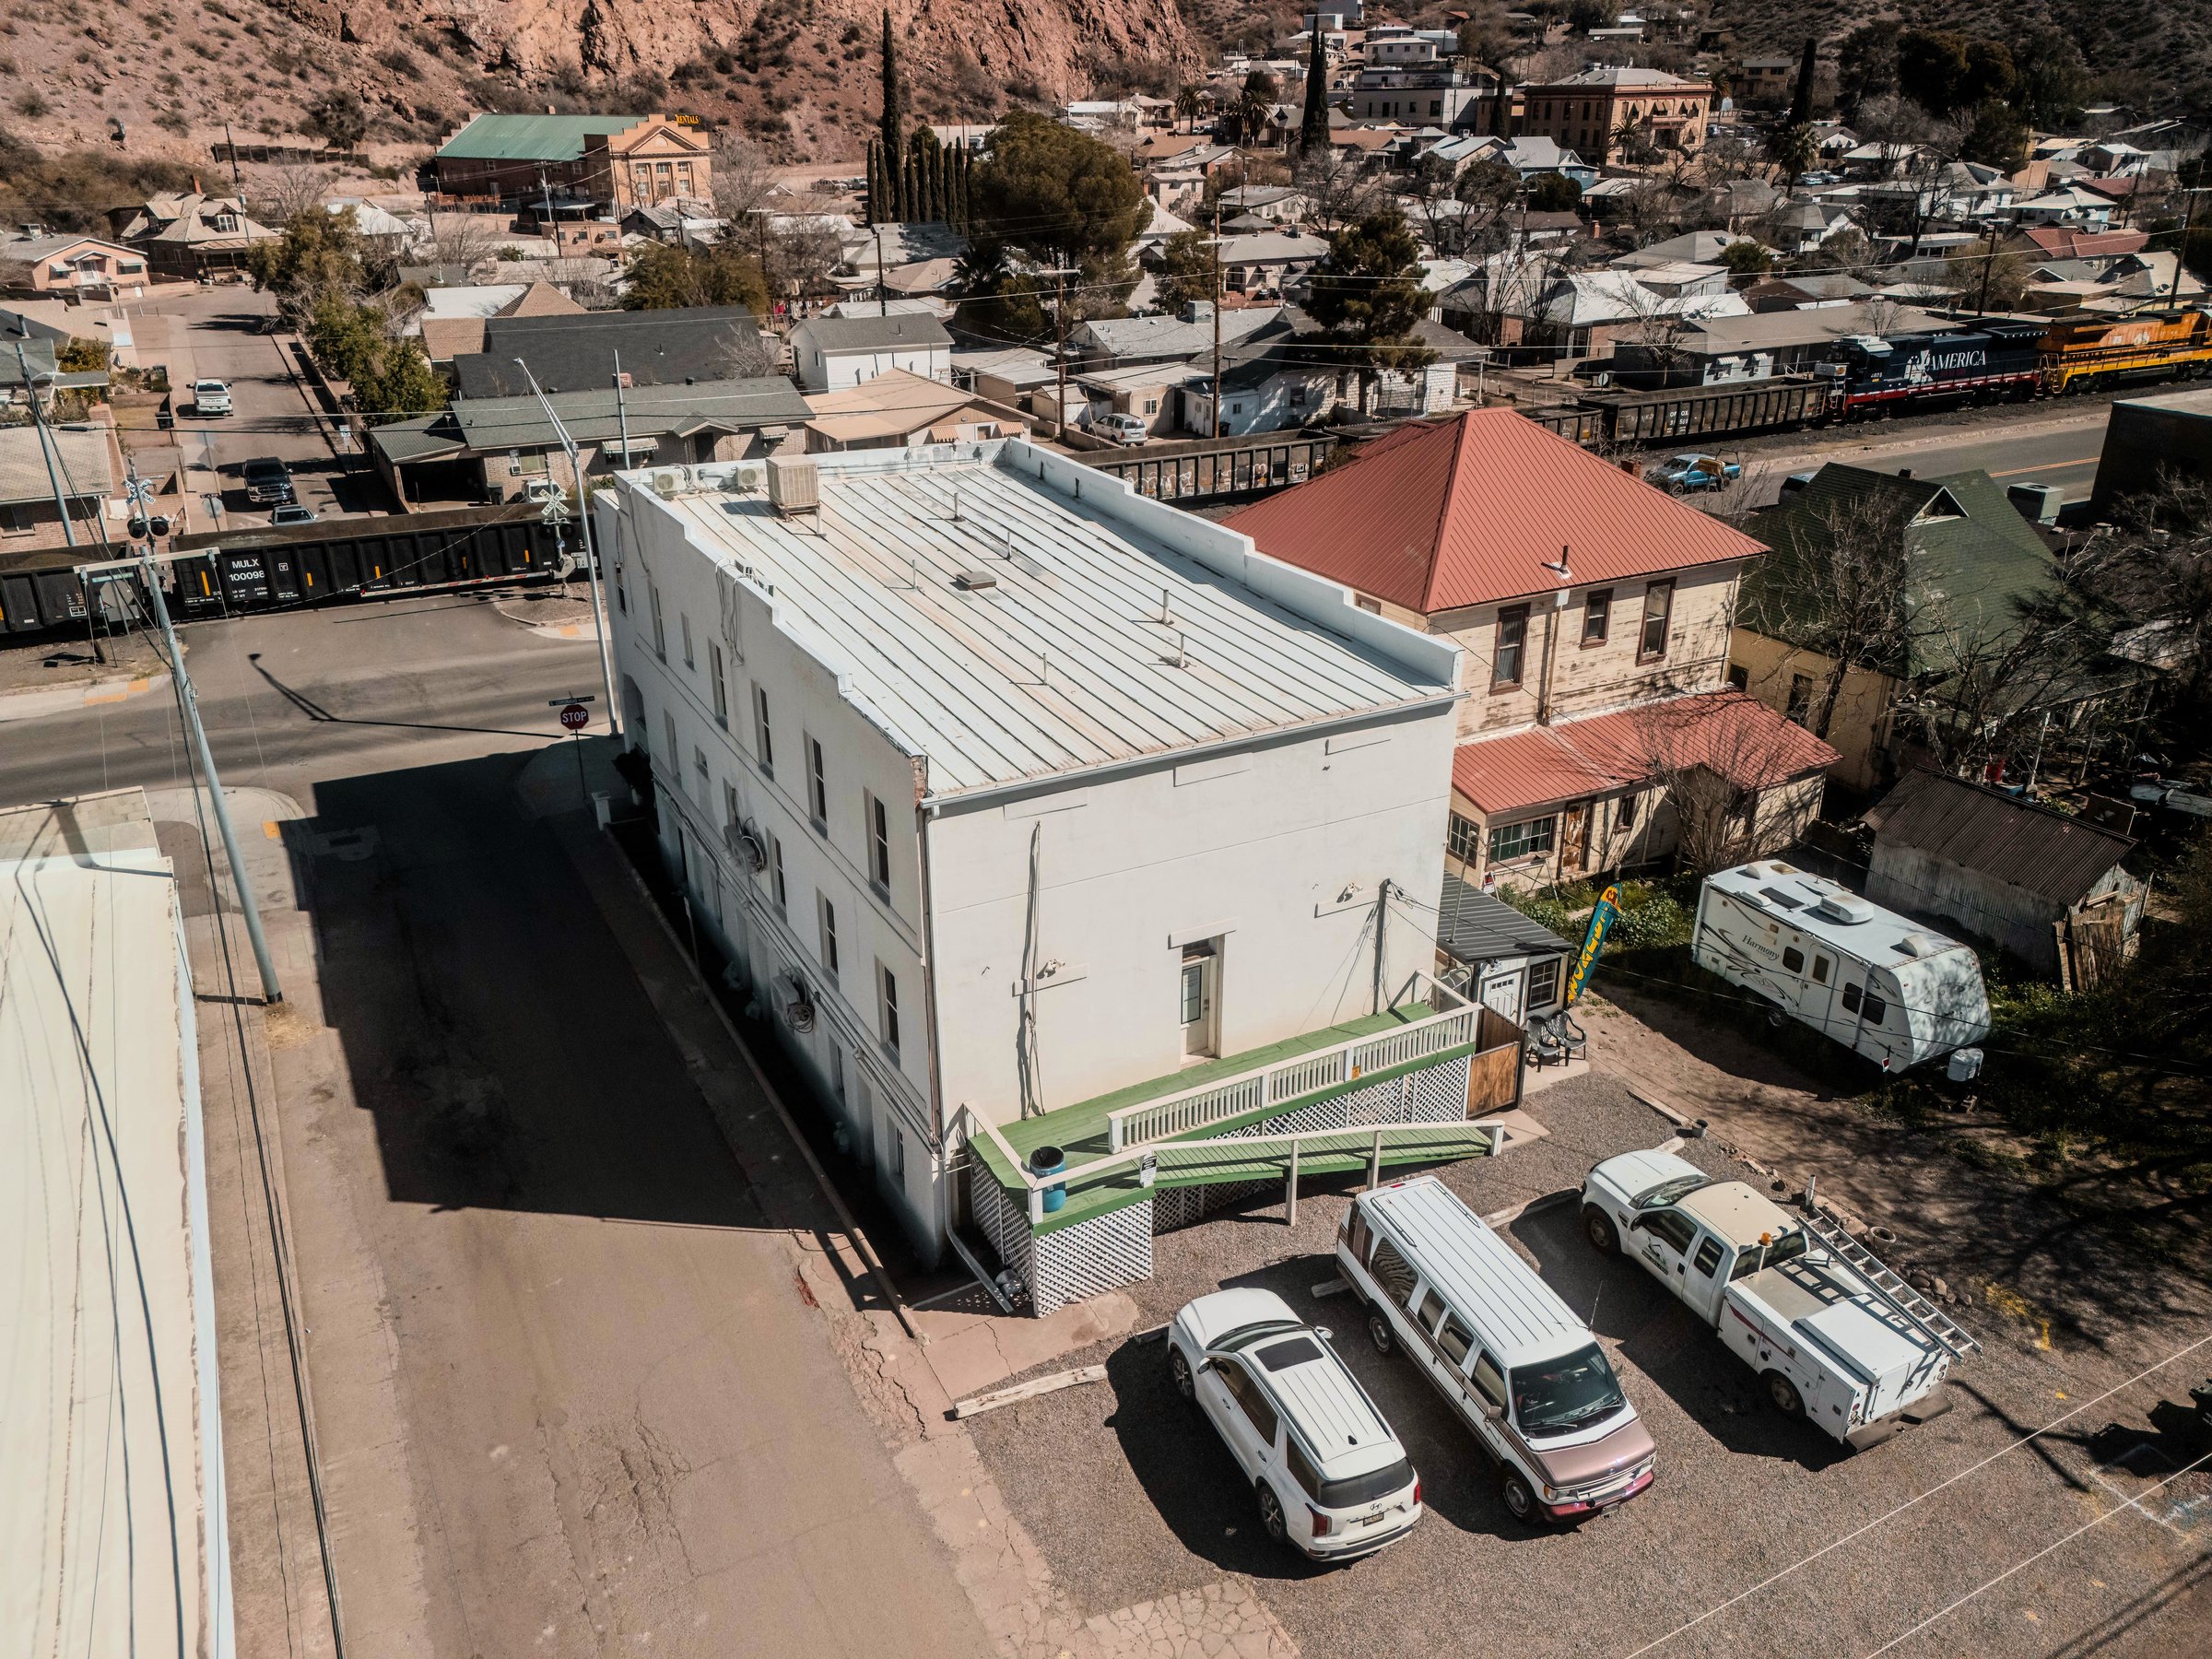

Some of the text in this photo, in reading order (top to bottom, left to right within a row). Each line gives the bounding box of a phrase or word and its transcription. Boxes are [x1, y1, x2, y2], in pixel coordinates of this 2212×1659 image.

[676, 114, 700, 124] RENTALS
[1928, 350, 1986, 371] AMERICA
[231, 559, 260, 569] MULX
[229, 570, 265, 582] 100098
[562, 711, 587, 723] STOP
[1742, 935, 1780, 960] Harmony
